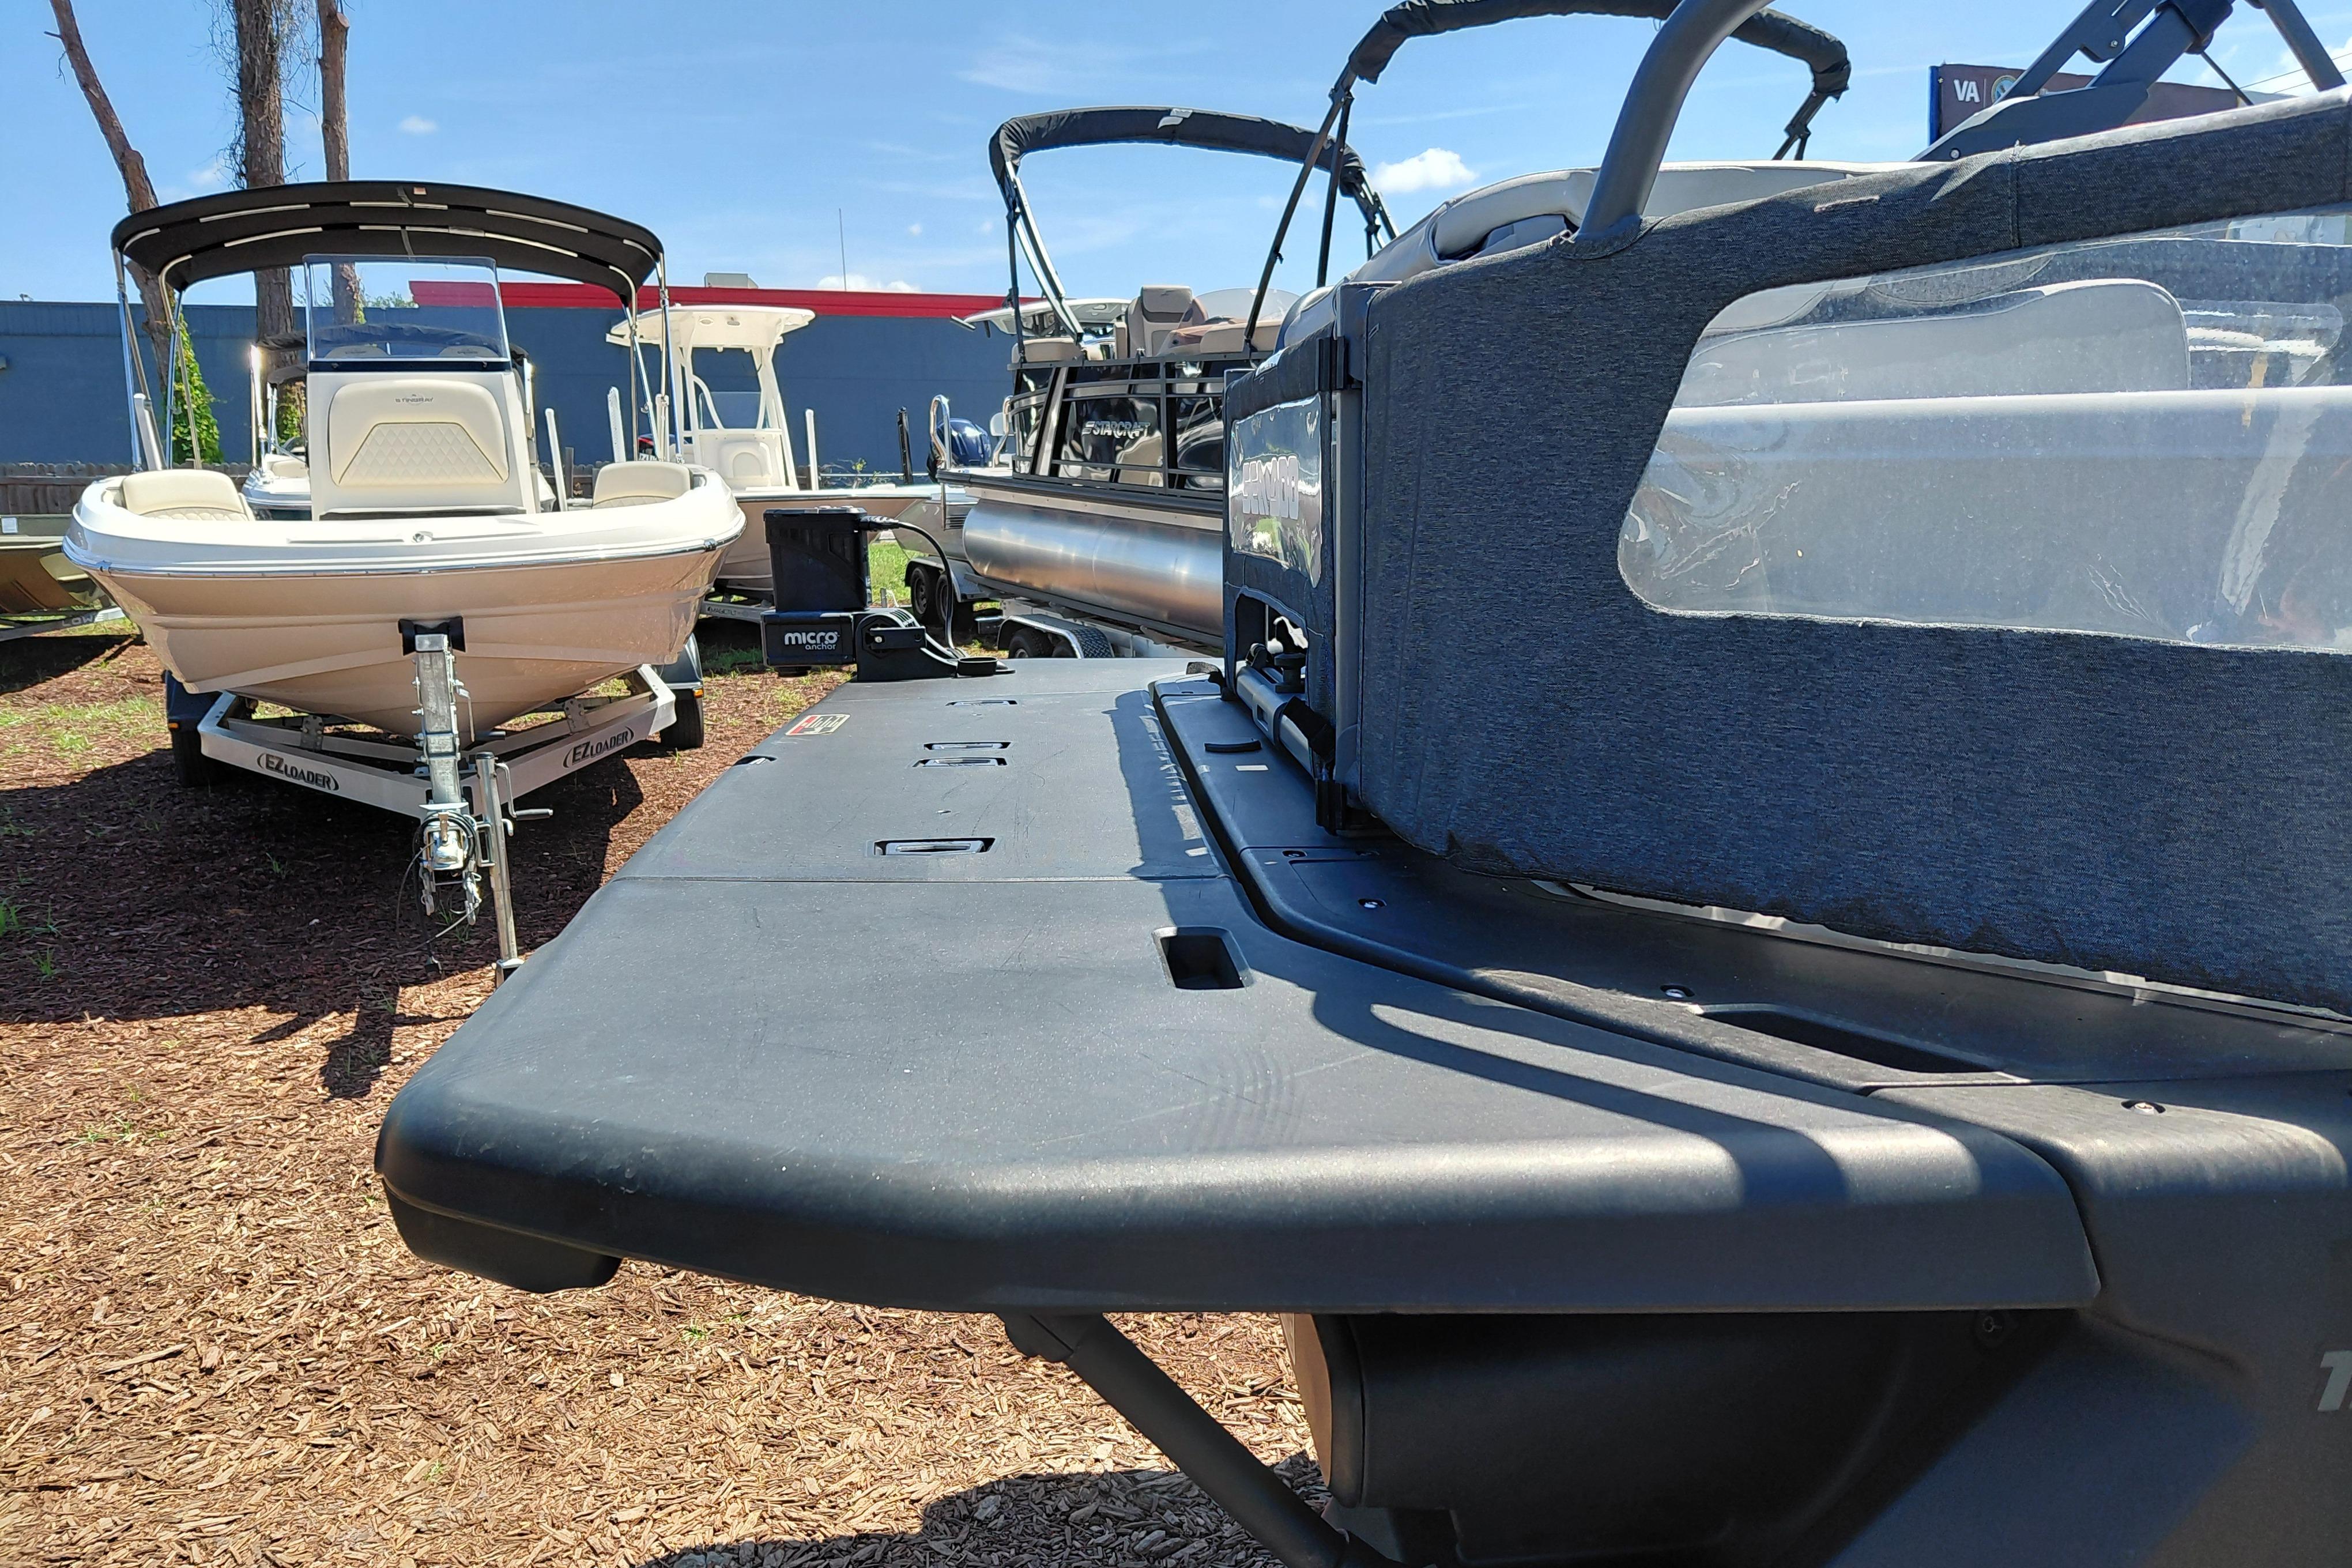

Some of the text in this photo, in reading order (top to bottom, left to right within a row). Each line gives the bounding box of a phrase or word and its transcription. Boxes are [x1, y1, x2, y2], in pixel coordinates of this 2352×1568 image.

[1953, 78, 1981, 103] VA
[1092, 421, 1151, 439] STARCRAFT
[785, 632, 838, 645] micro
[805, 642, 836, 650] anchor
